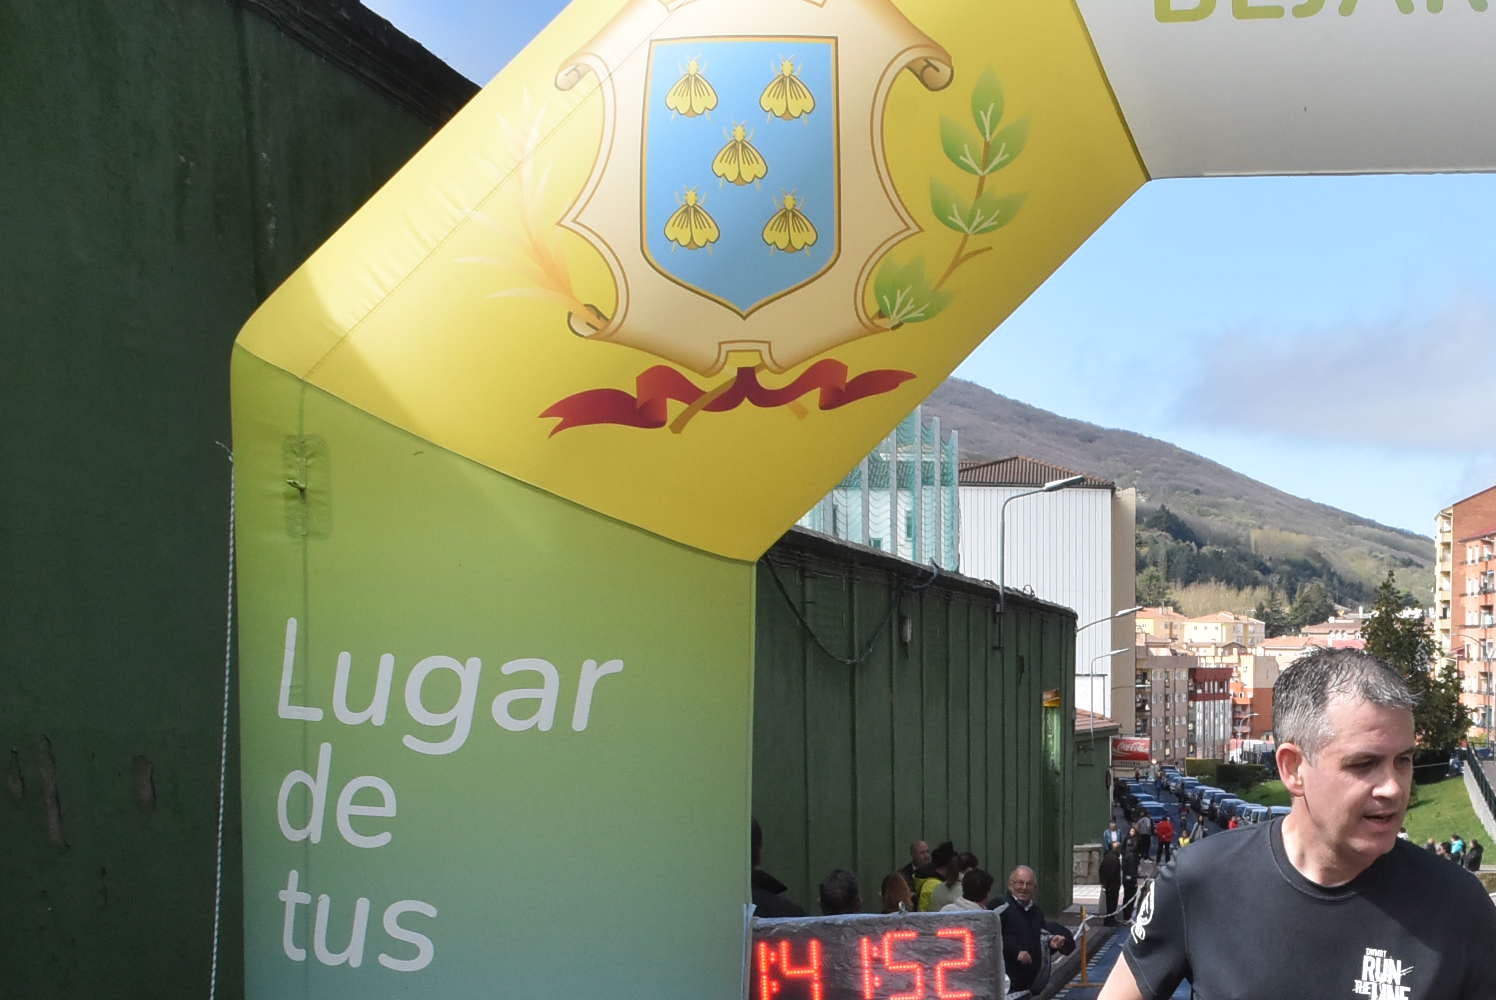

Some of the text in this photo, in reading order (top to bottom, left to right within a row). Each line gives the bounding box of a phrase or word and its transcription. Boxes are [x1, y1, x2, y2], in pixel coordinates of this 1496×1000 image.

[277, 616, 624, 755] Lugar
[277, 742, 397, 849] de
[278, 869, 438, 972] tus
[1361, 955, 1402, 986] RUN
